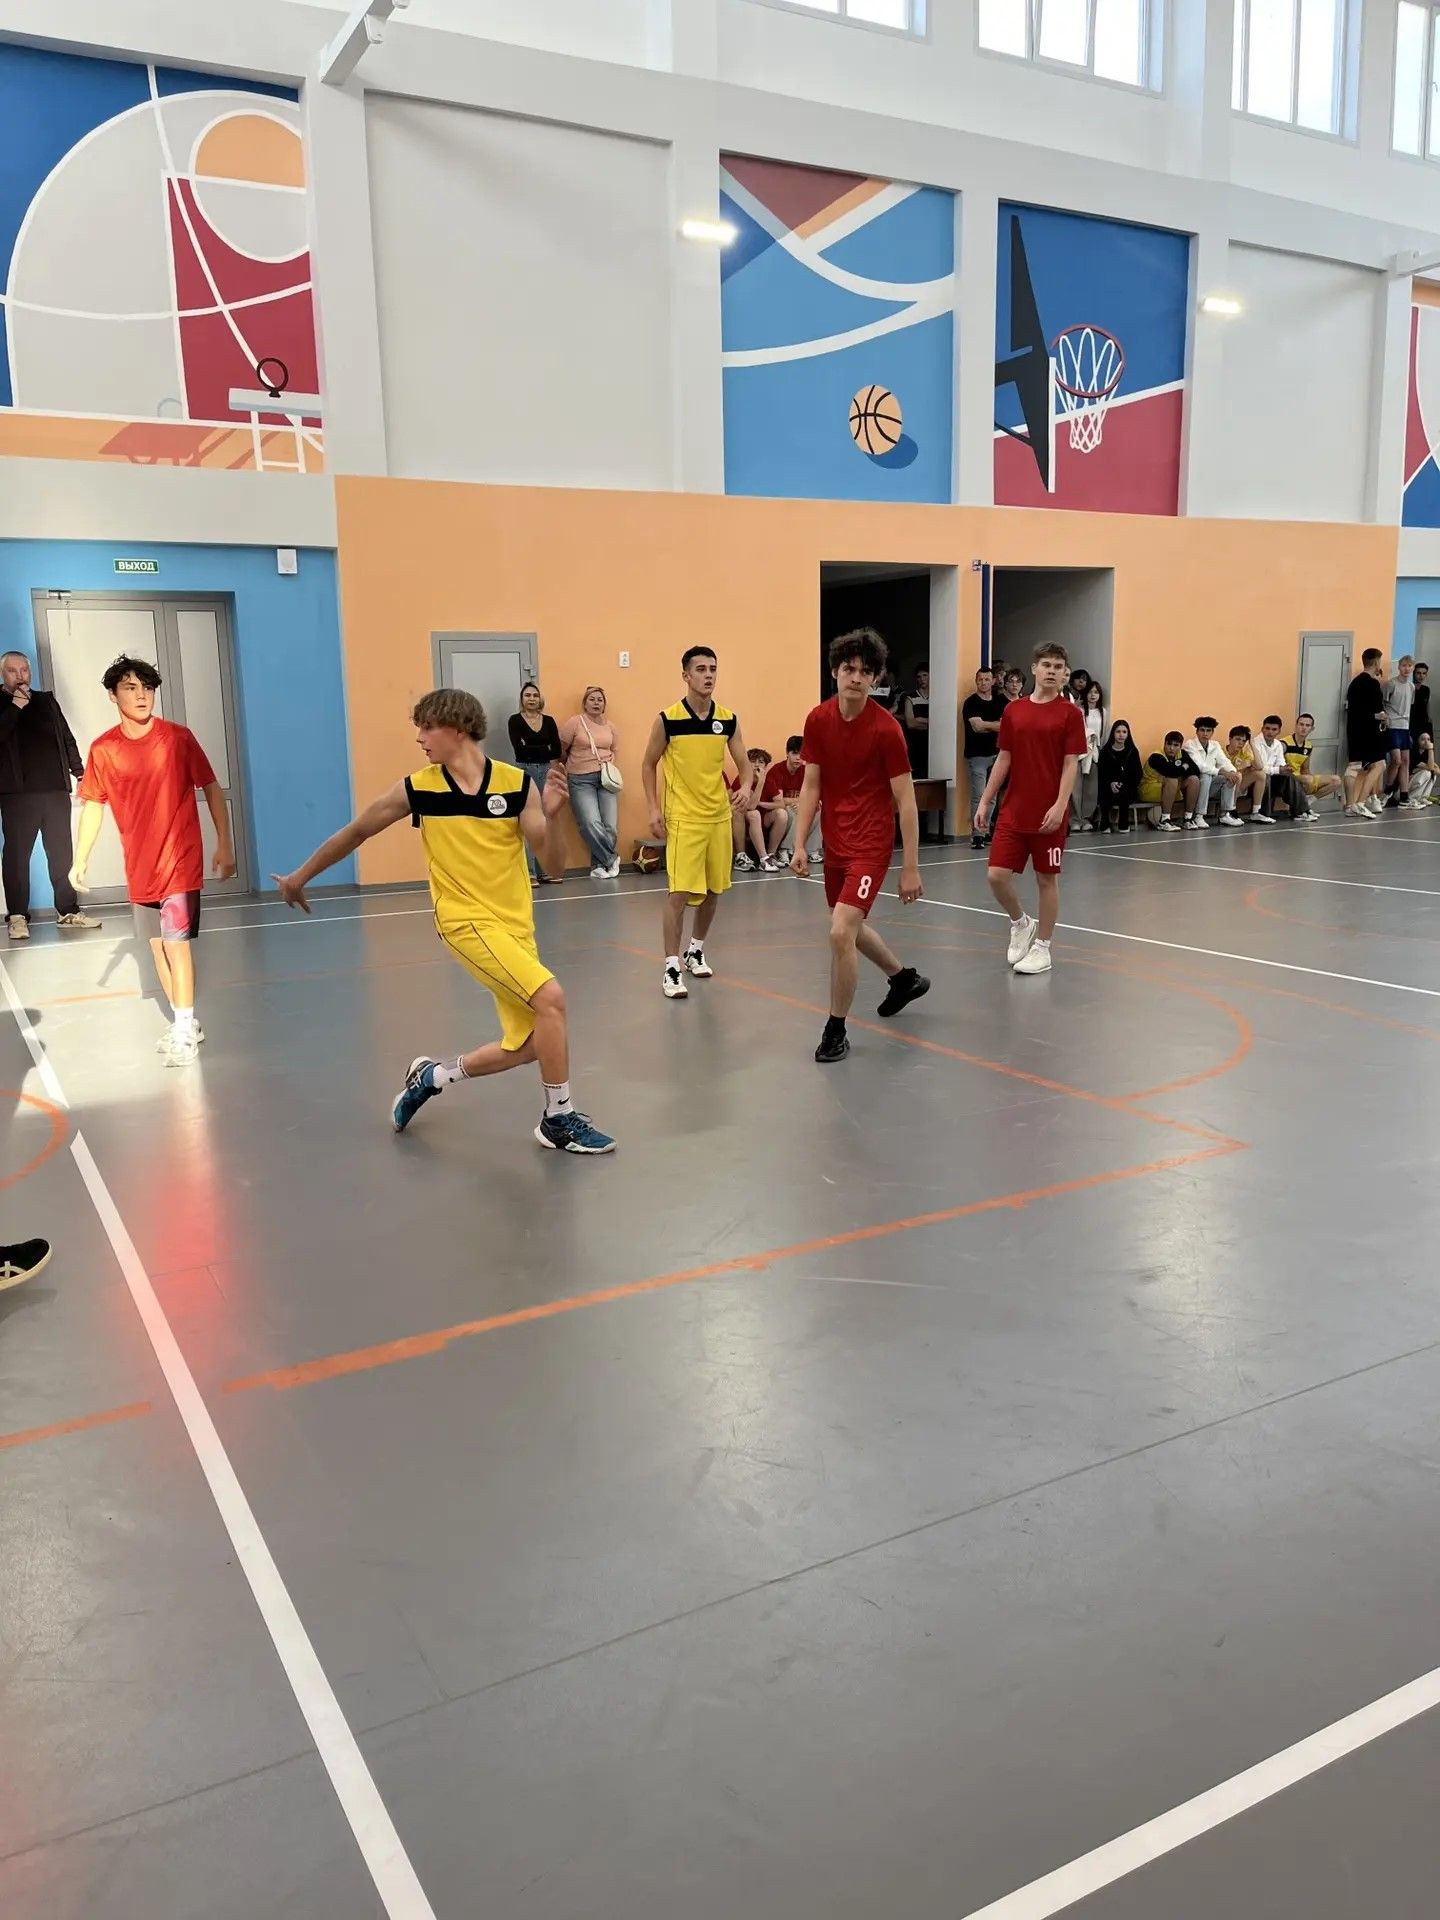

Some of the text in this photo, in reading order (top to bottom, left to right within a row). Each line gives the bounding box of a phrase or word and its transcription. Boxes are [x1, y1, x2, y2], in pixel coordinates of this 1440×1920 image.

[118, 561, 156, 571] ВЫХОД
[1047, 847, 1061, 866] 10
[857, 875, 872, 899] 8
